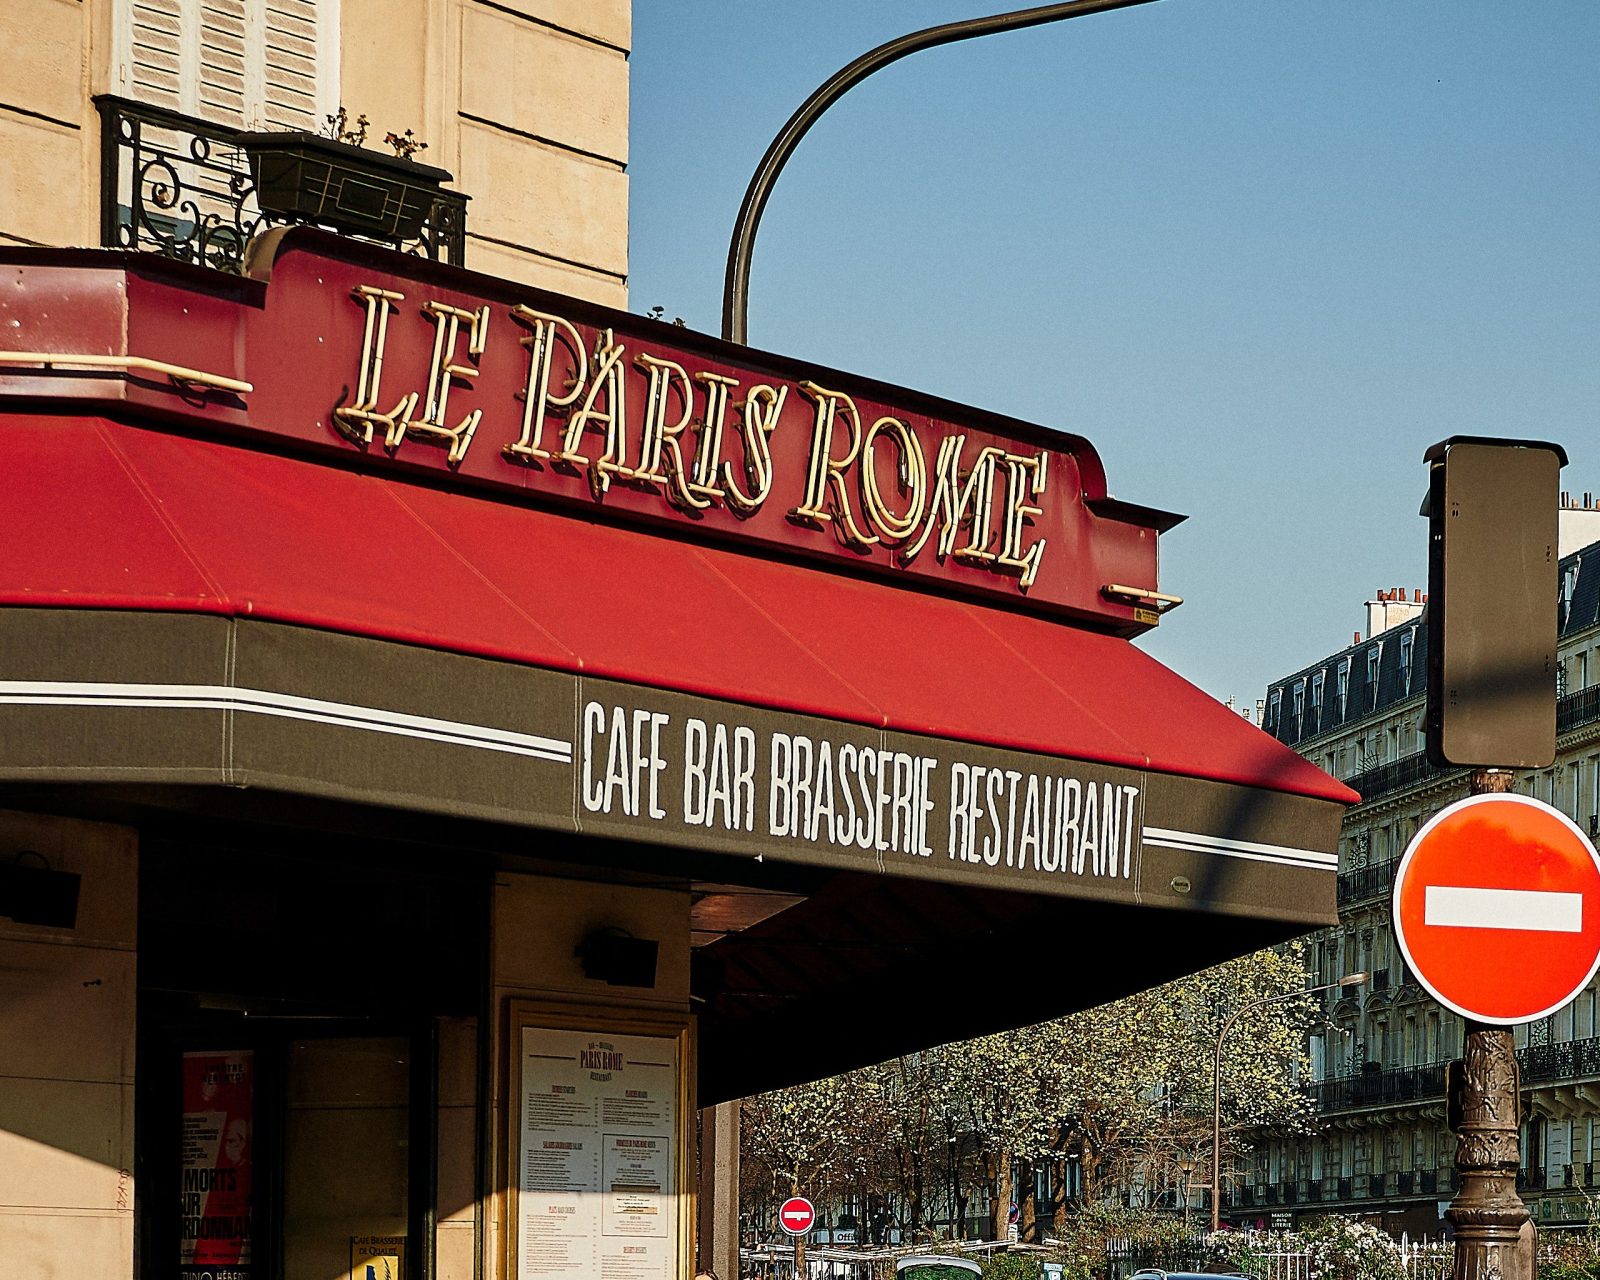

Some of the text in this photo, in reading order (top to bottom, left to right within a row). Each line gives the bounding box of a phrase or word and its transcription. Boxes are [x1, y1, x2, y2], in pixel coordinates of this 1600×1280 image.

[336, 284, 1048, 588] LE PARIS ROME
[582, 700, 1140, 880] CAFE BAR BRASSERIE RESTAURANT
[580, 1050, 624, 1071] PARIS ROME
[184, 1168, 236, 1192] MORTS
